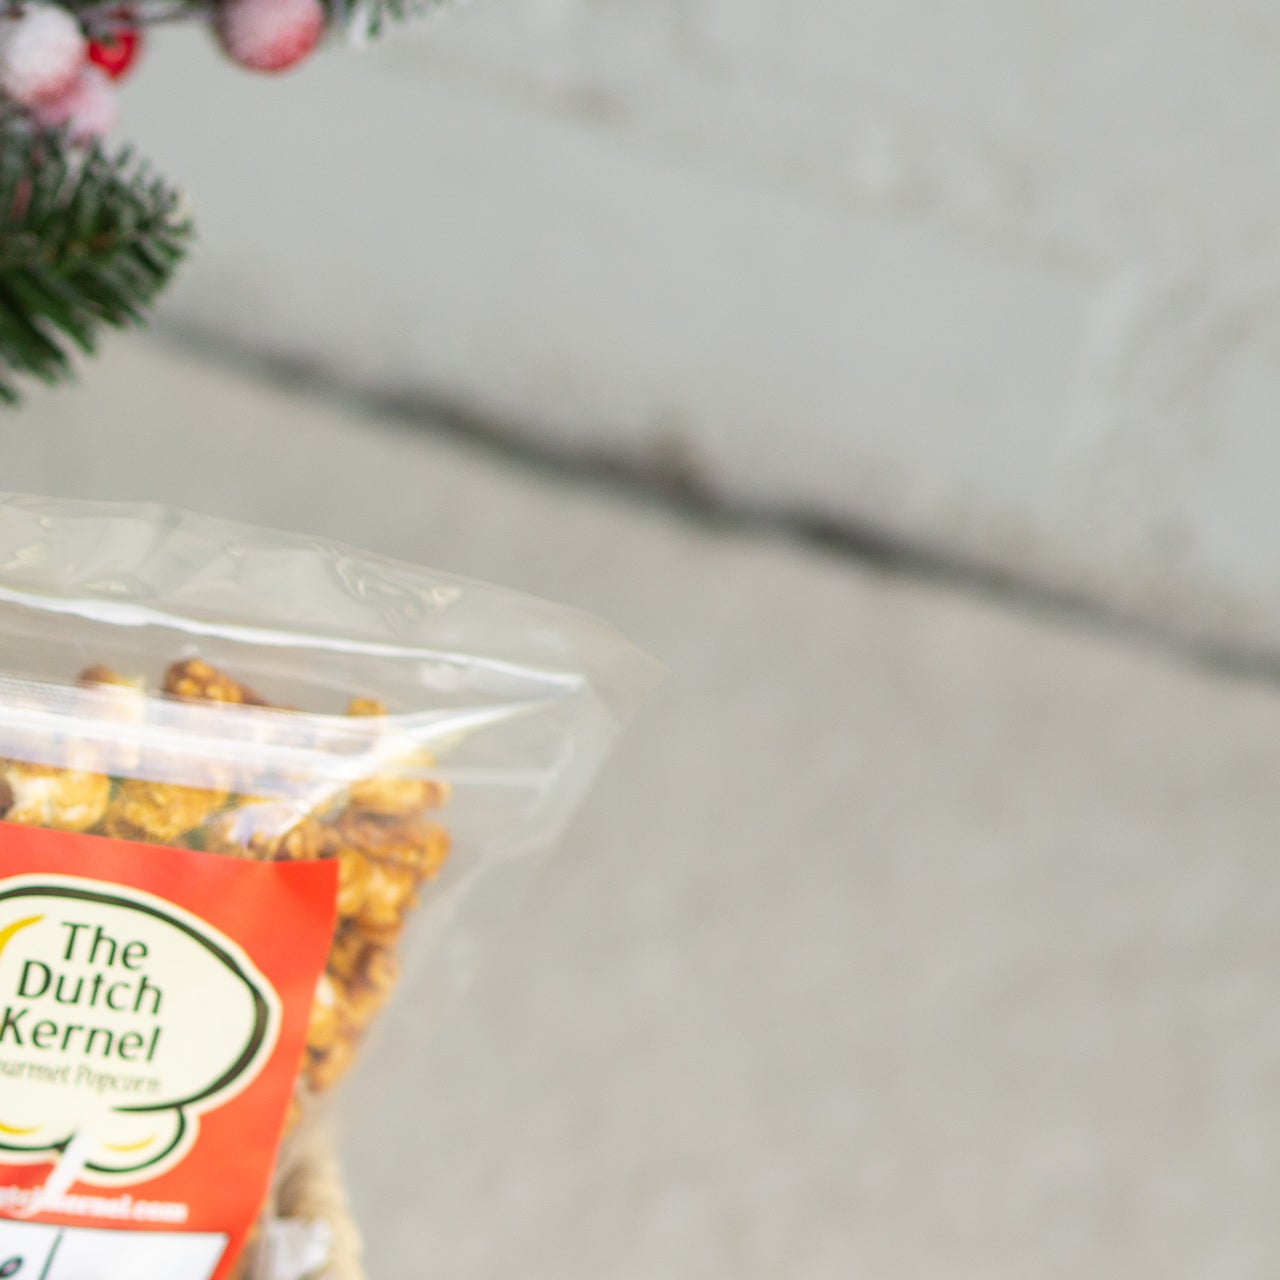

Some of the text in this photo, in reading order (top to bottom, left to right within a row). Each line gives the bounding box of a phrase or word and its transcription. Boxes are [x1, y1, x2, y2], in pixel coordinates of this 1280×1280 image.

[60, 922, 149, 971] The
[17, 960, 164, 1015] Dutch
[76, 1062, 163, 1097] Popcorn
